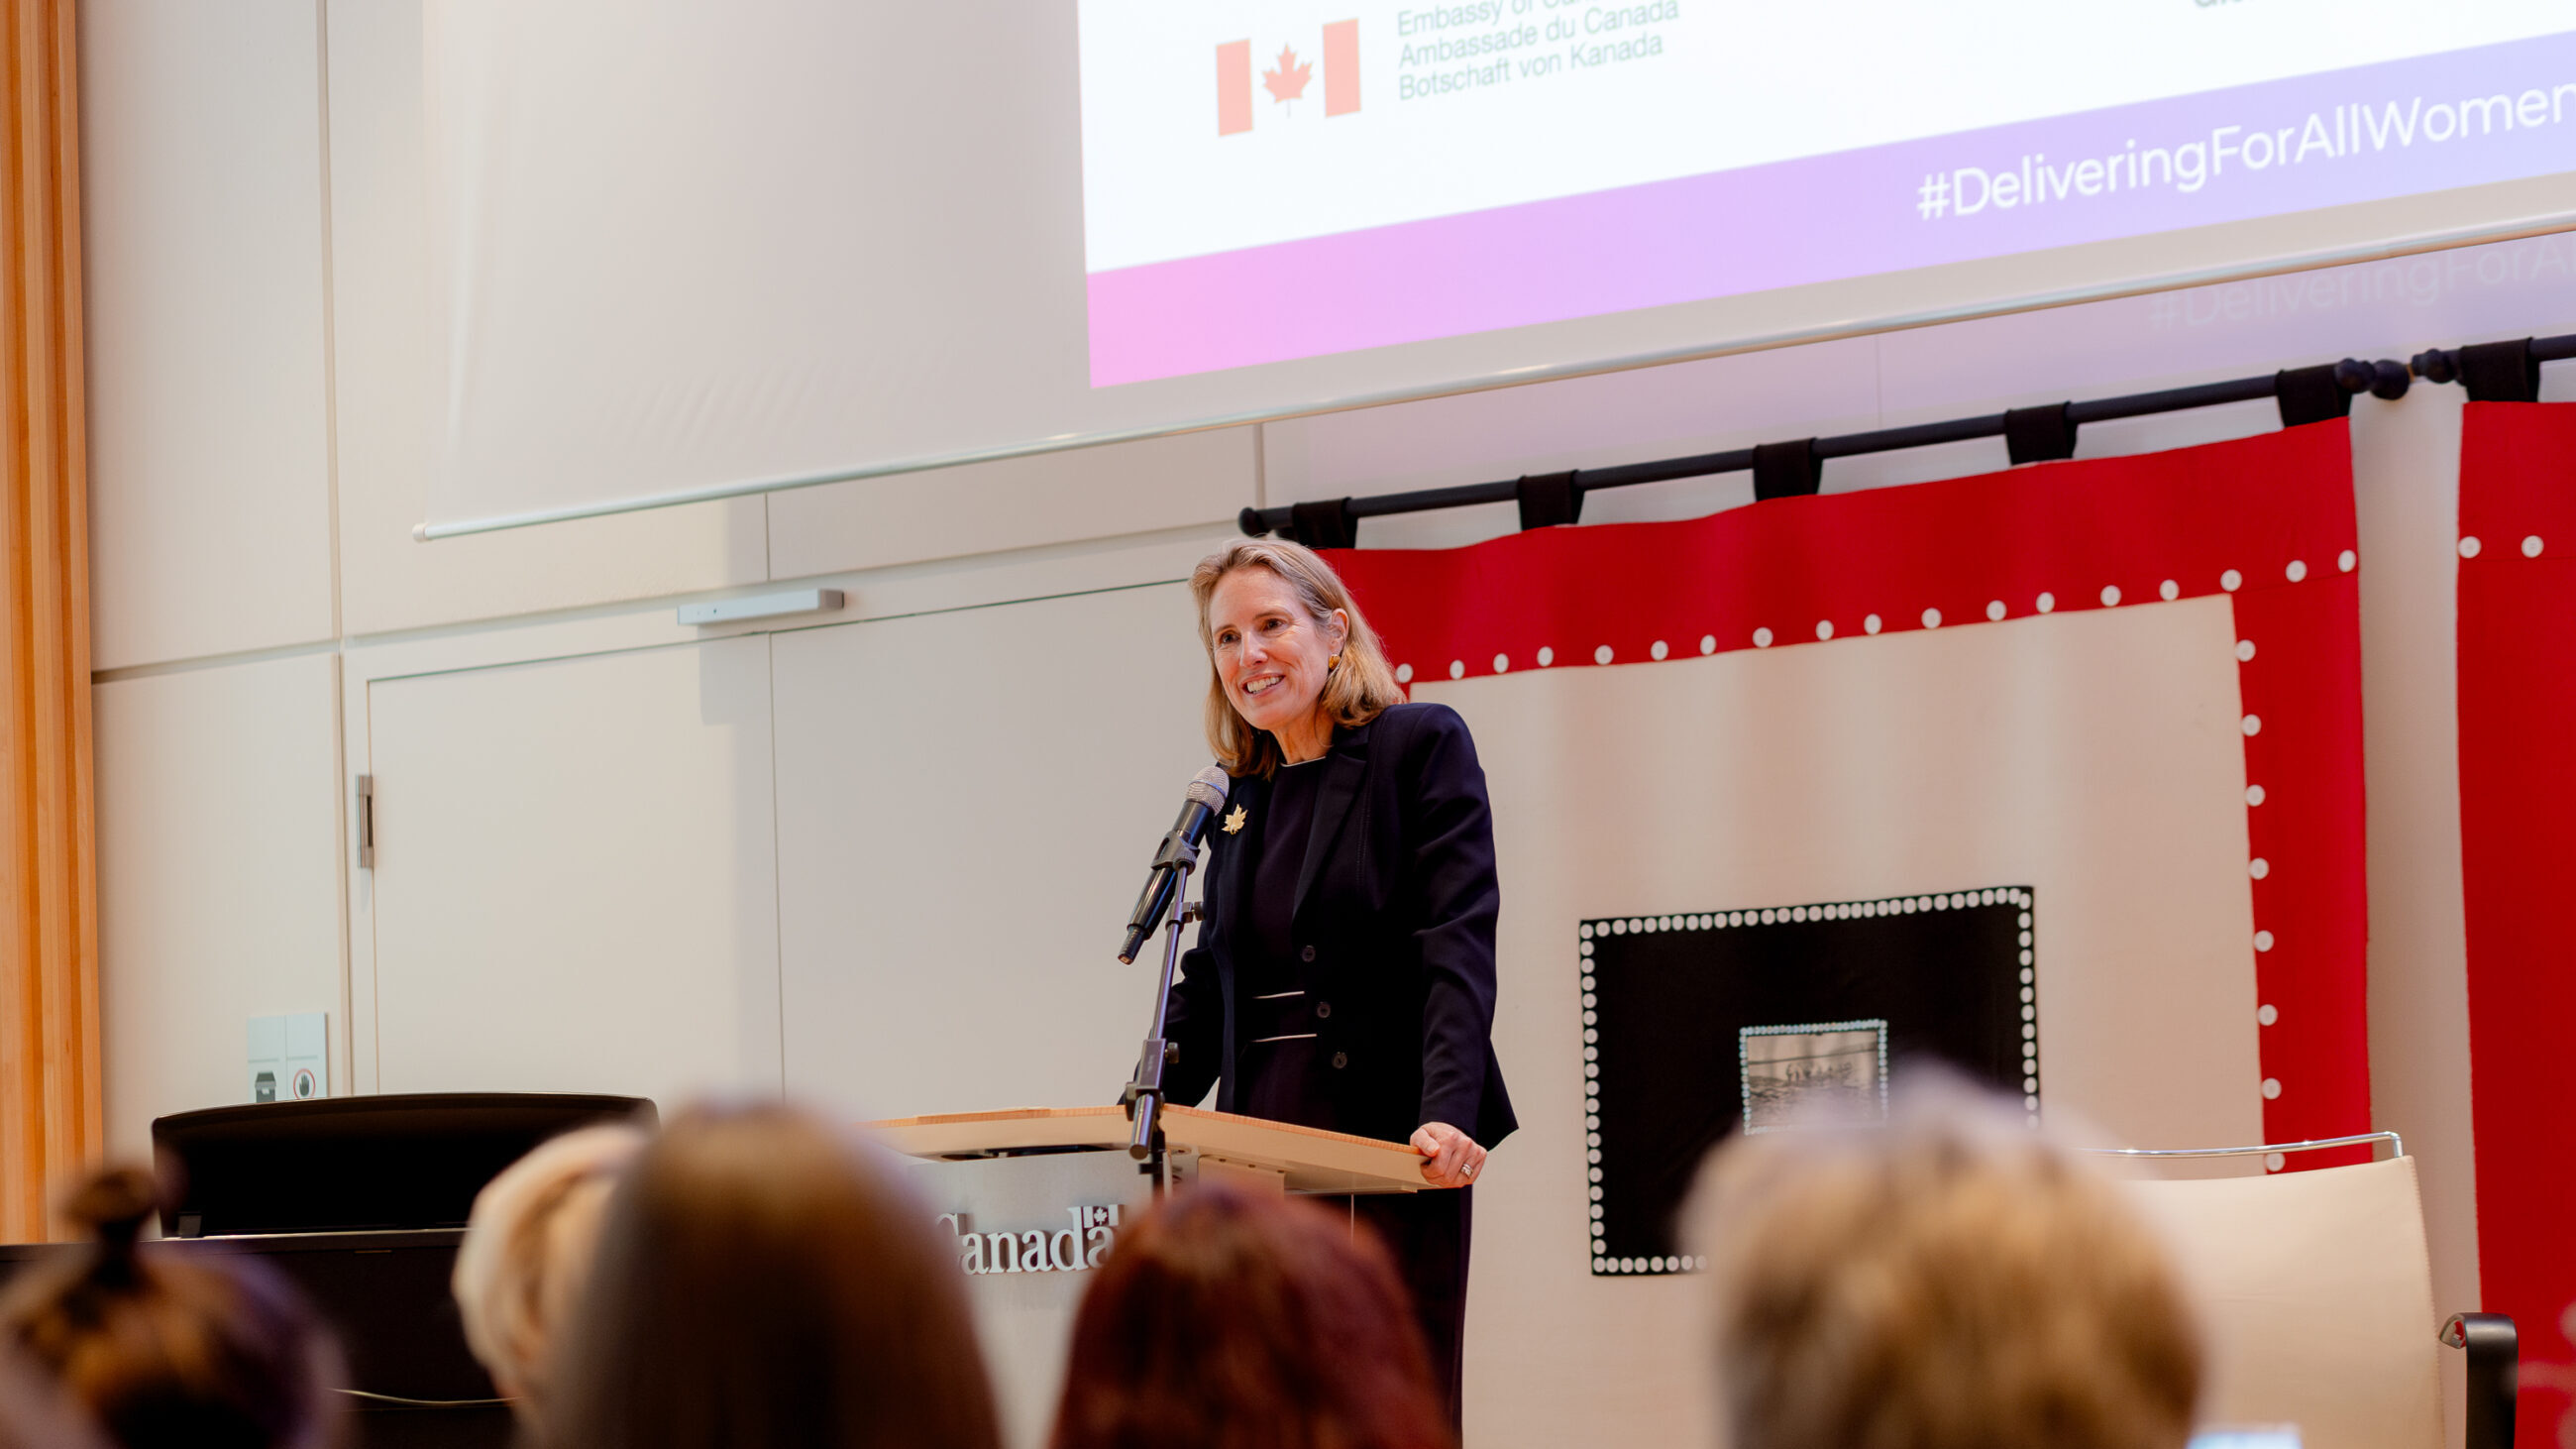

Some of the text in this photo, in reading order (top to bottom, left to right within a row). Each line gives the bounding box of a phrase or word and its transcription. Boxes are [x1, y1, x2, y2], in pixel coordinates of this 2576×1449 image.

[1397, 0, 1504, 37] Embassy
[1398, 0, 1680, 68] Ambassade du Canada
[1398, 31, 1664, 100] Botschaft von Kanada
[1916, 81, 2576, 220] #DeliveringForAllWomen
